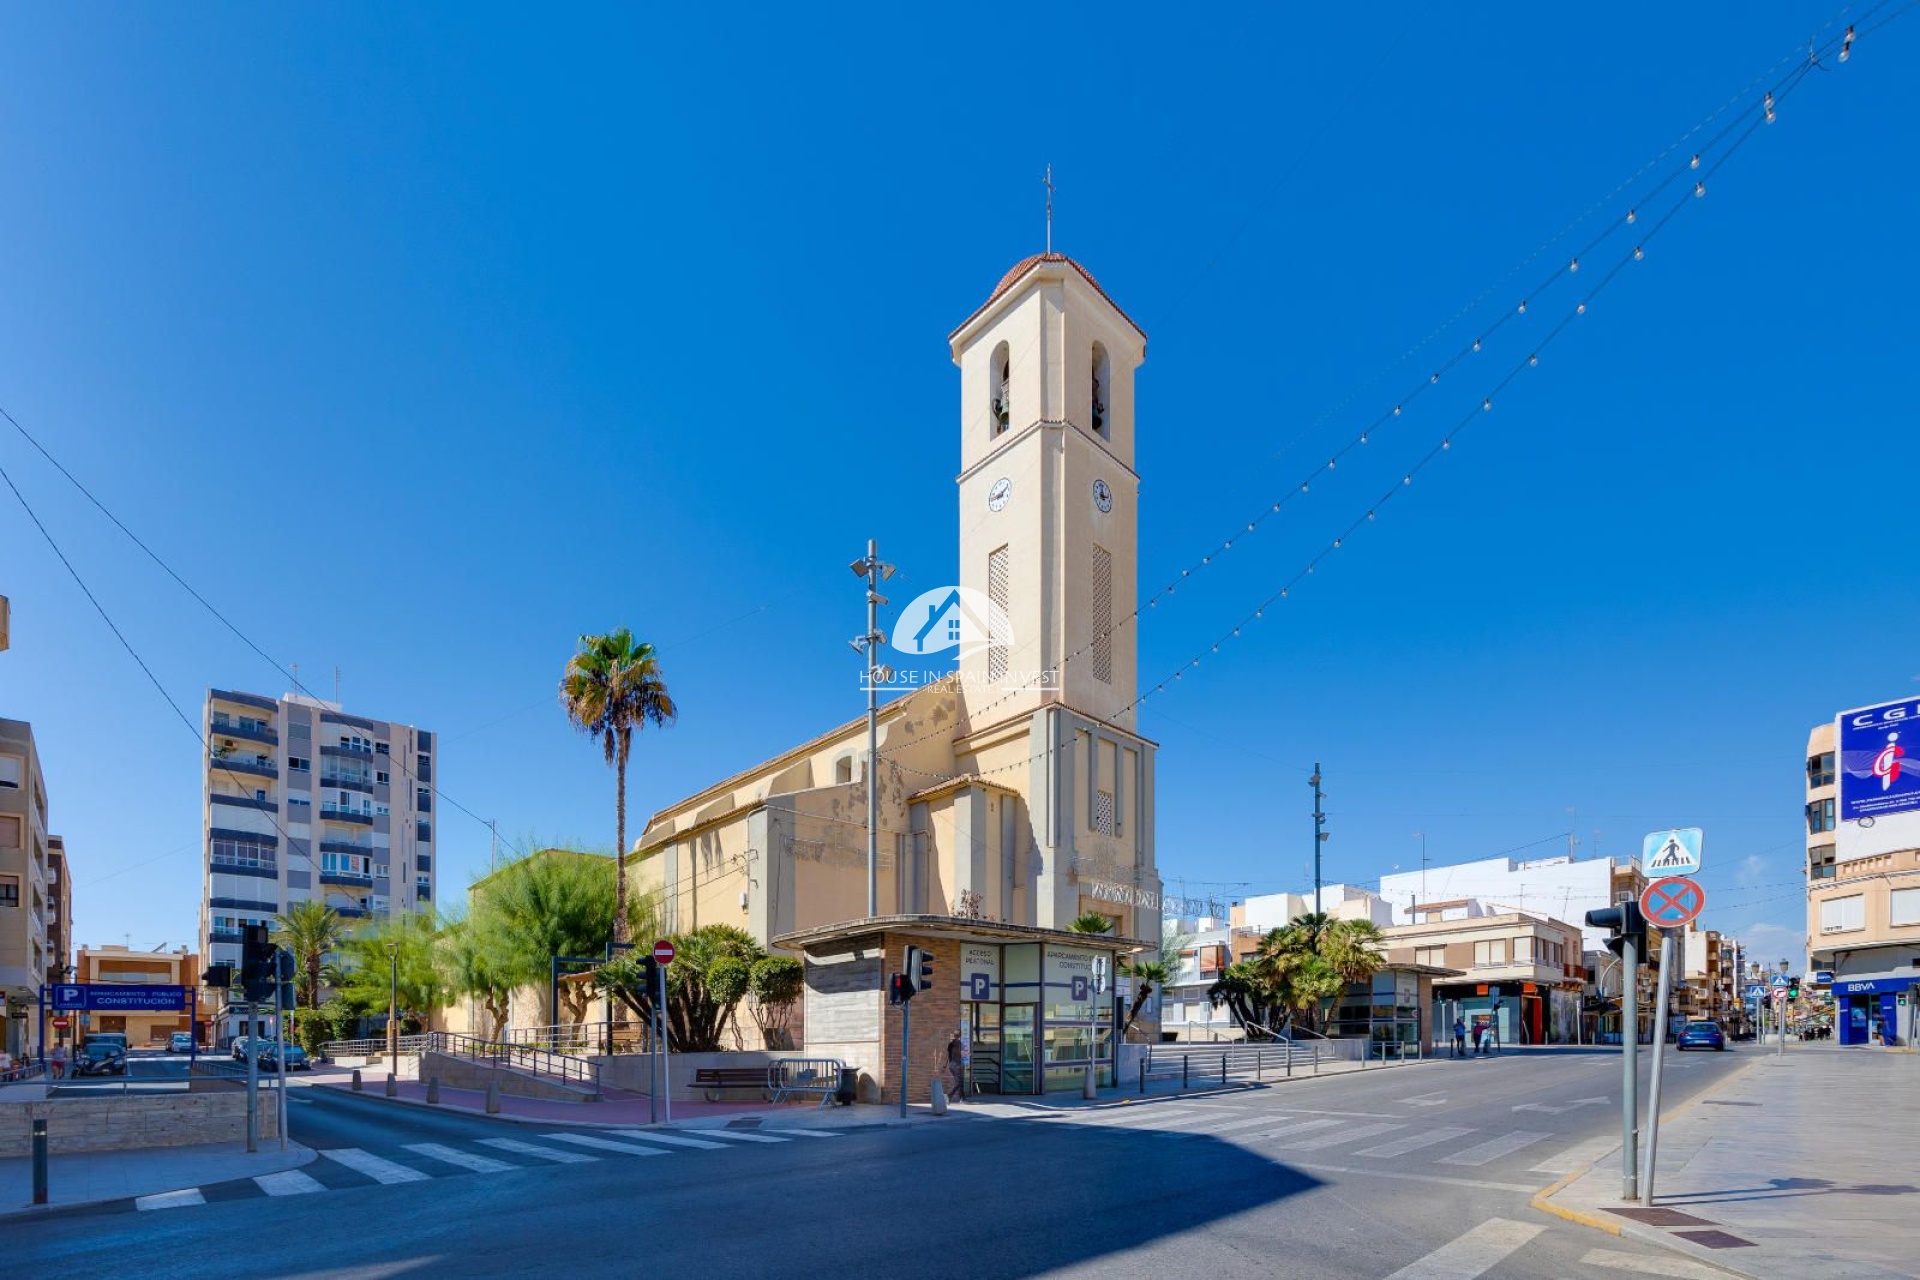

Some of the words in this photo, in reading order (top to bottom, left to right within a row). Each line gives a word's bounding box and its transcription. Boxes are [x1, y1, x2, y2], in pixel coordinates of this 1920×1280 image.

[975, 978, 986, 995] P
[1075, 980, 1085, 997] P
[1848, 982, 1875, 992] BBVA
[63, 988, 79, 1001] P
